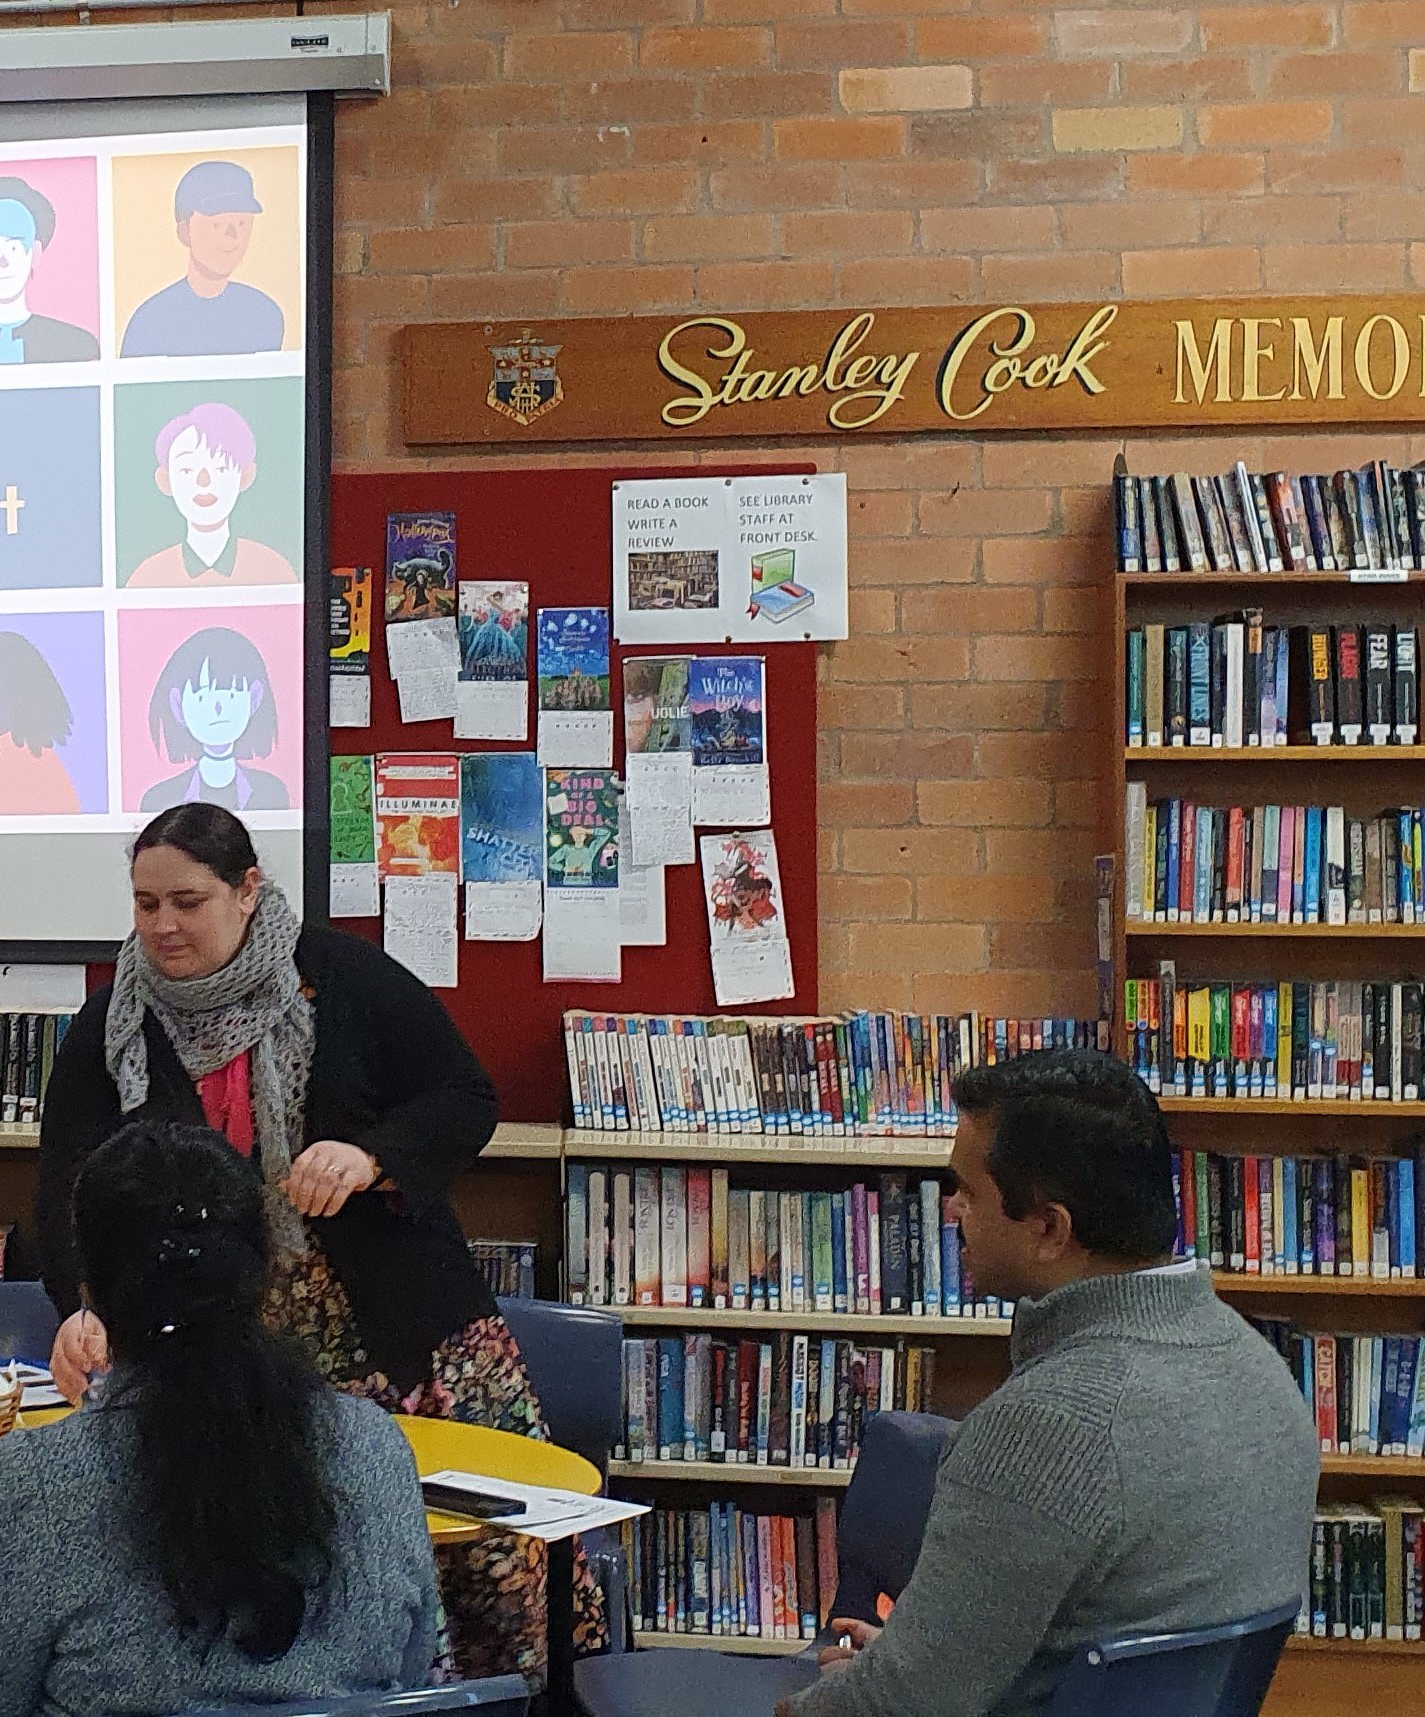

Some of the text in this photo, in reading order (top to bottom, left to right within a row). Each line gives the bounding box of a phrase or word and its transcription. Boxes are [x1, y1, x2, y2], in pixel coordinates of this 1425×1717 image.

[657, 312, 921, 430] Stanley
[939, 304, 1119, 420] Cook
[627, 496, 710, 510] READ A BOOK
[739, 494, 814, 508] SEE LIBRARY
[627, 518, 679, 531] WRITE A
[739, 512, 794, 526] STAFF AT
[627, 536, 675, 549] REVIEW
[740, 532, 780, 545] FRONT
[1368, 633, 1389, 671] FEAR
[560, 777, 604, 790] KIND
[380, 799, 458, 810] ILLUMINAE
[560, 813, 604, 827] DEAL
